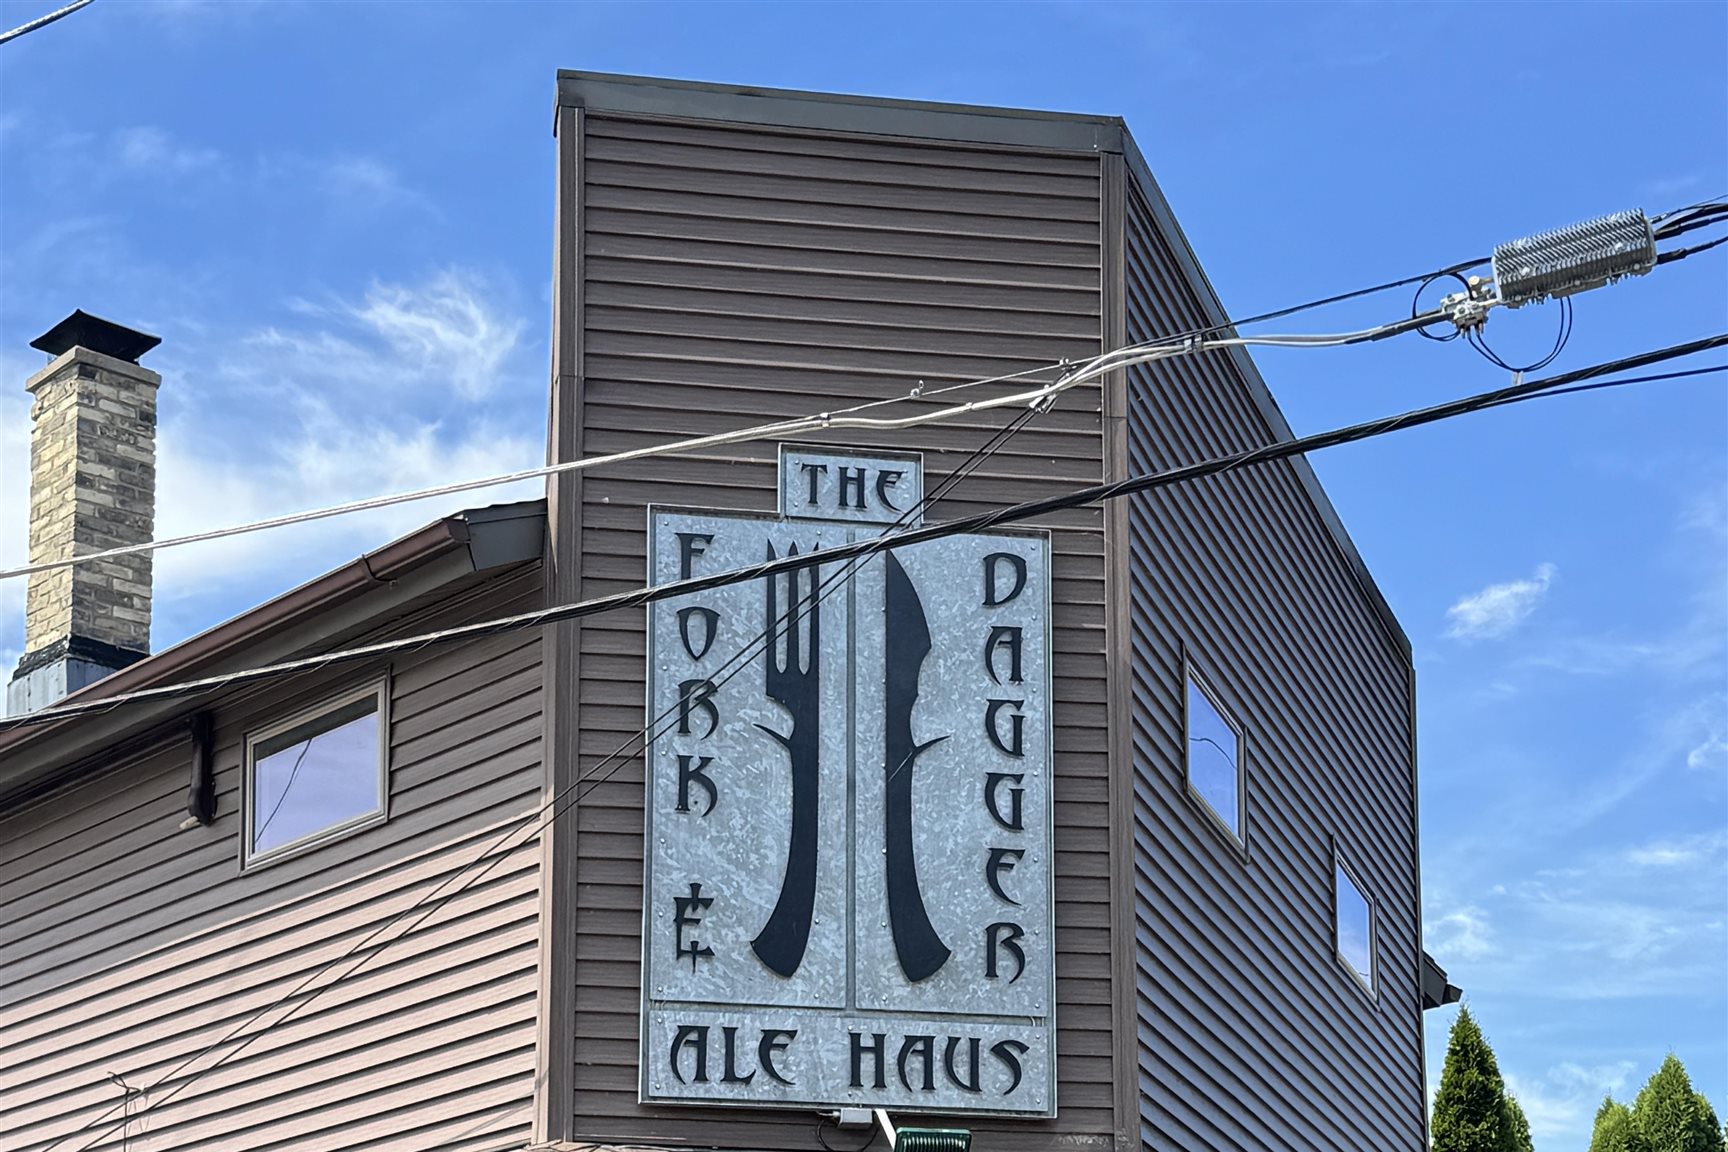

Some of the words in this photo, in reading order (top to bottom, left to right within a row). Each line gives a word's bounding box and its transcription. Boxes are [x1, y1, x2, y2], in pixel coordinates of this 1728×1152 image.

[801, 464, 904, 511] THE
[675, 532, 720, 817] FORK
[983, 552, 1028, 985] DAGGER
[670, 1025, 798, 1085] ALE
[848, 1031, 1030, 1095] HAUS
